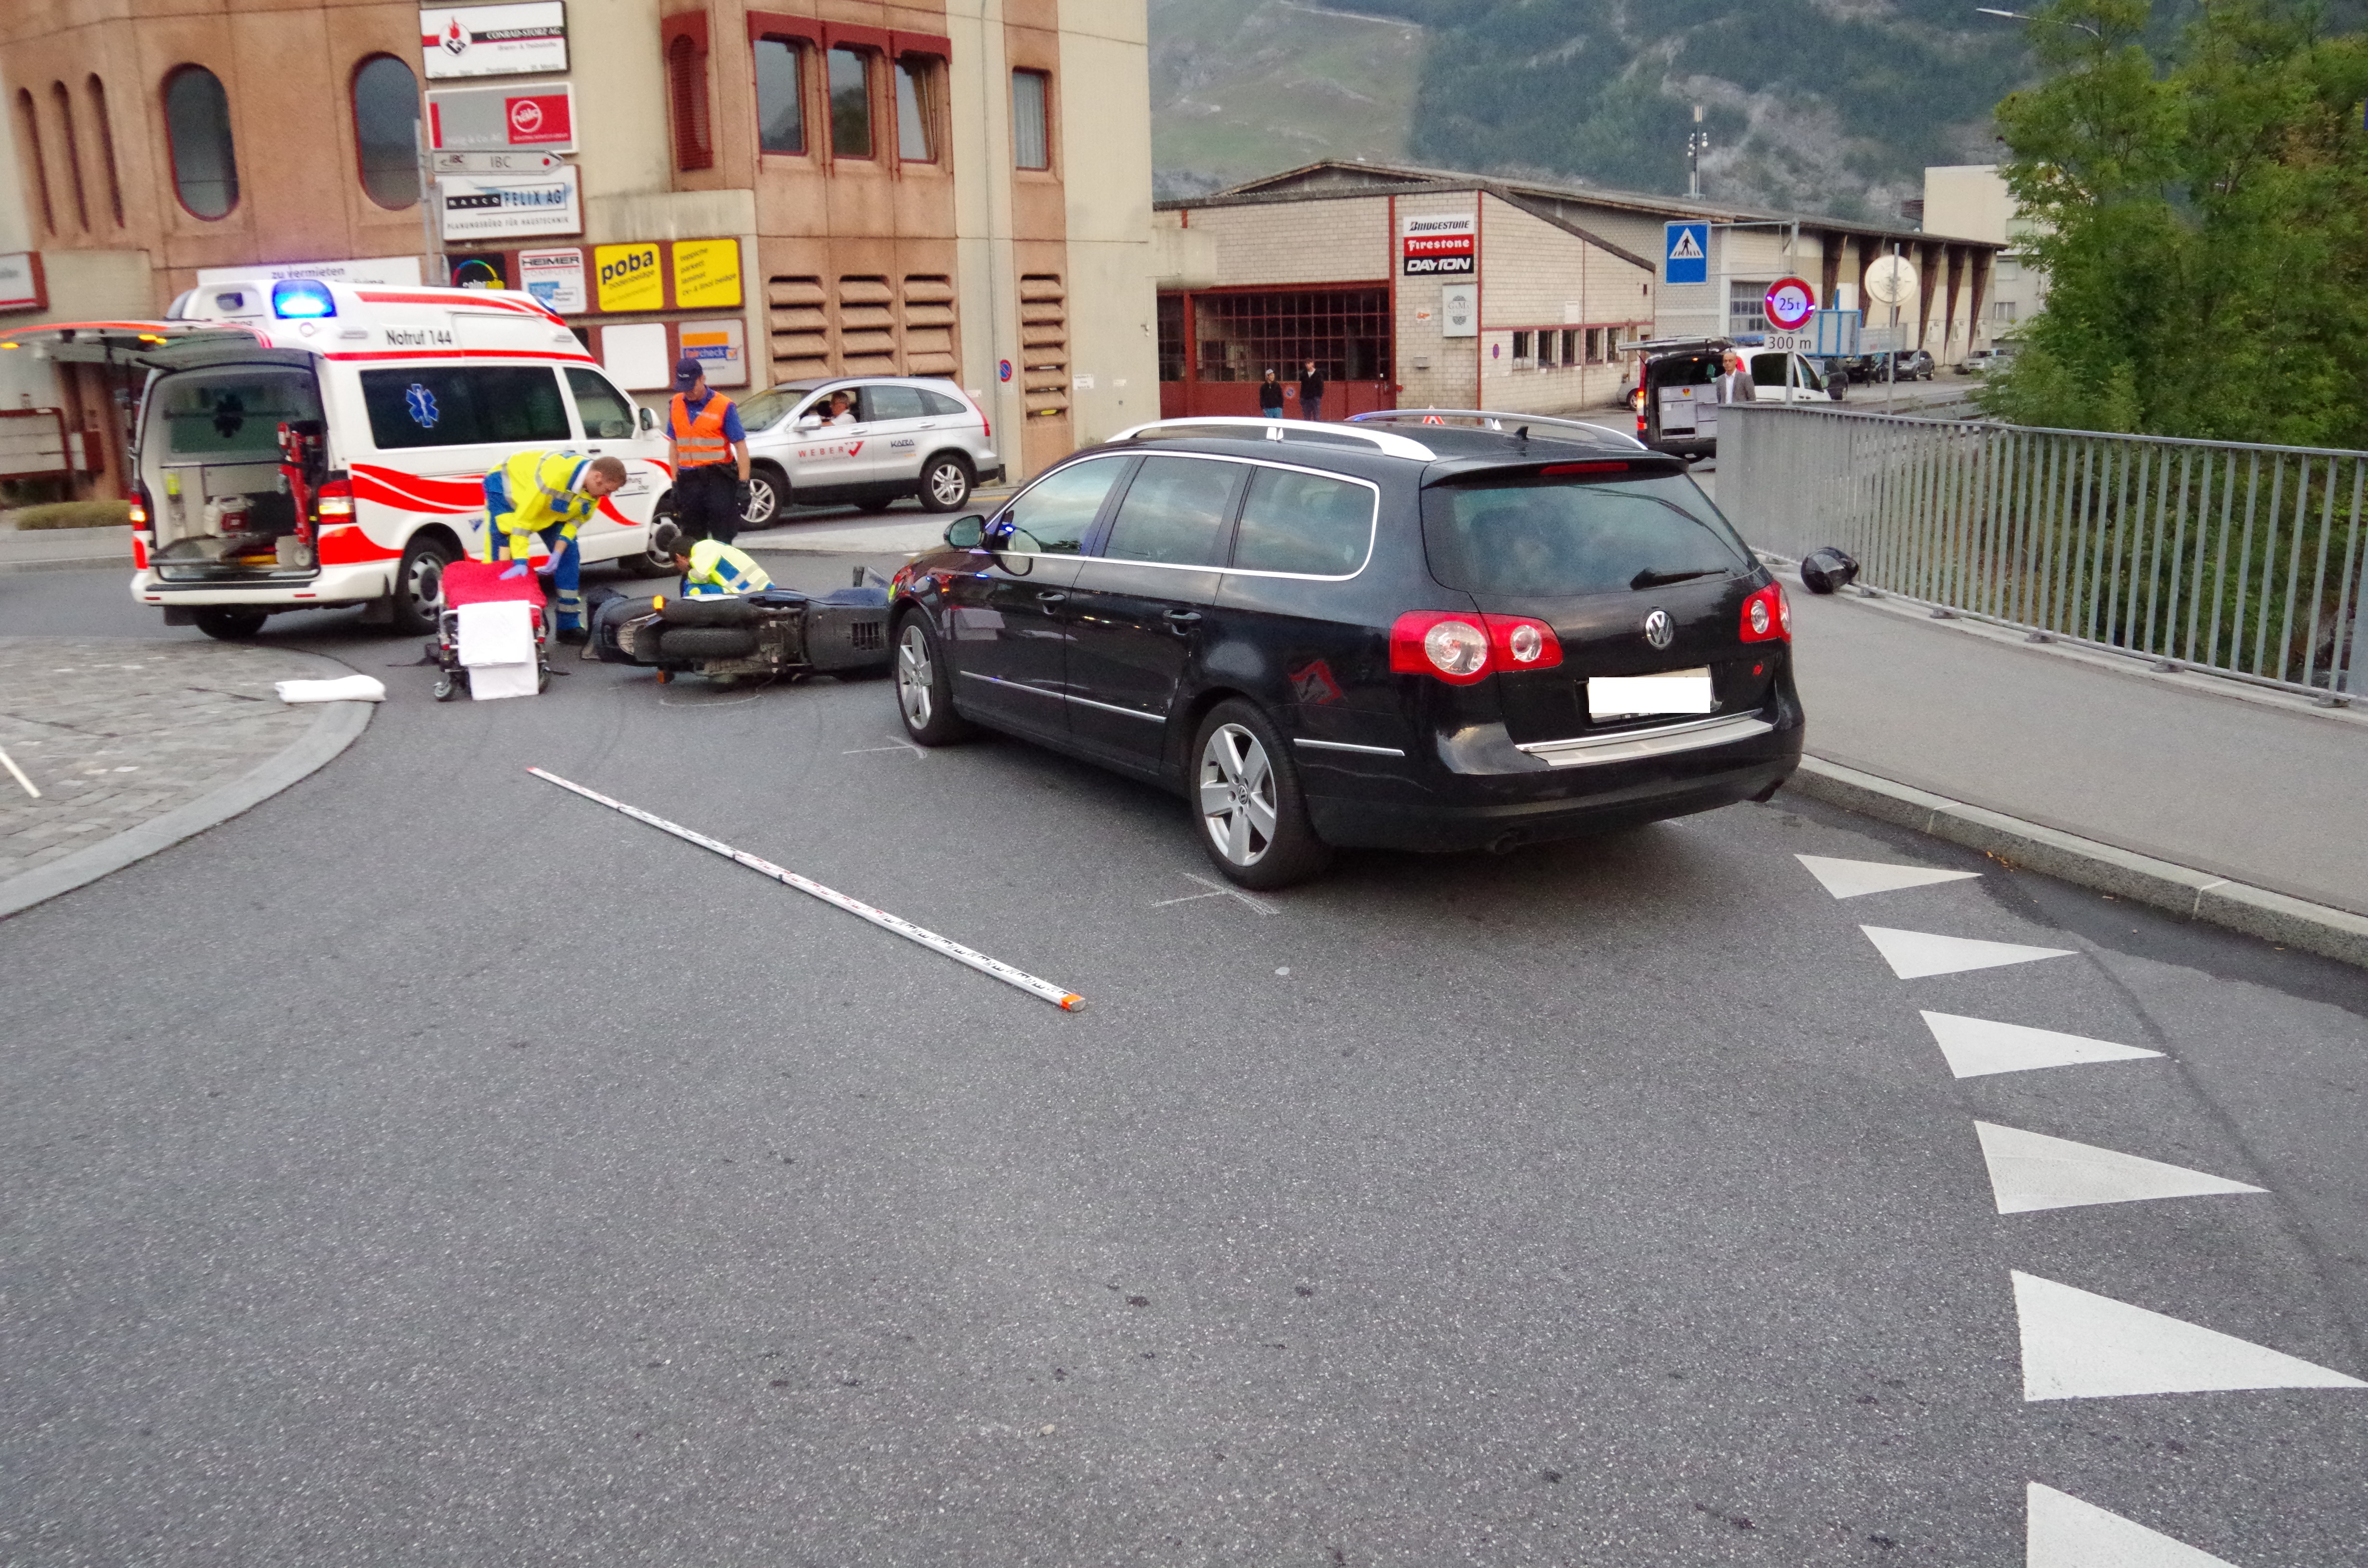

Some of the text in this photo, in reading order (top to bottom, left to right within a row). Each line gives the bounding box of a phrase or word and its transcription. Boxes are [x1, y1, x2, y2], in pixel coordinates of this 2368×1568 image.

[490, 156, 512, 168] IBC
[448, 189, 562, 207] MARCO FELIX AG
[1409, 220, 1470, 231] BRIDGESTONE
[1407, 239, 1470, 252] Firestone
[522, 256, 580, 266] HEIMER
[1406, 257, 1471, 271] DAYTON
[271, 267, 345, 279] zu vermieten
[523, 269, 581, 277] COMPUTER
[601, 250, 654, 285] poba
[385, 329, 453, 345] Notruf 144
[1768, 336, 1811, 349] 300 m
[798, 446, 844, 457] WEBER
